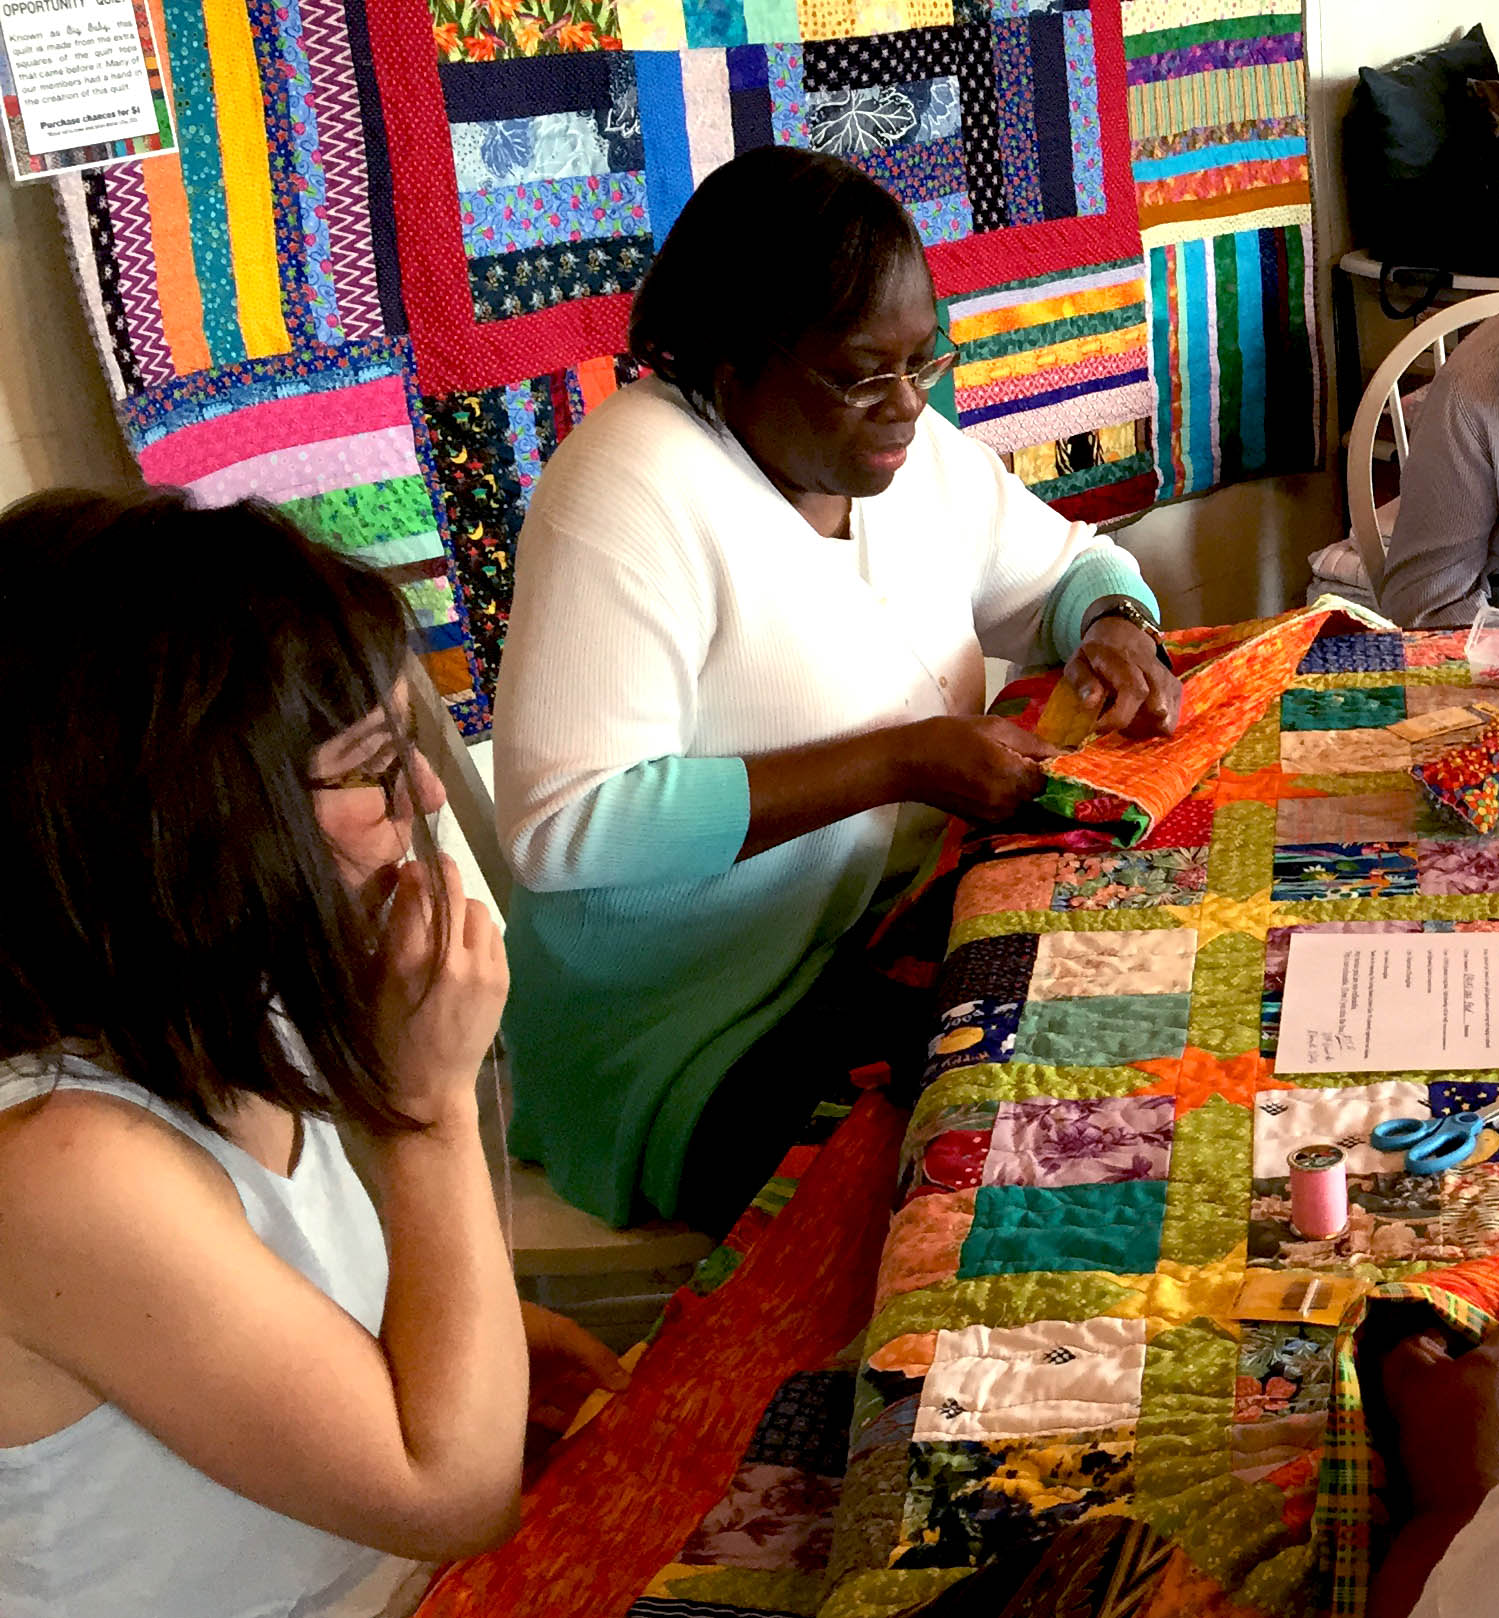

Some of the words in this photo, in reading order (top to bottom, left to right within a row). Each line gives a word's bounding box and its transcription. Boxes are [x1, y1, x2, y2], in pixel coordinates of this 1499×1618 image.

[3, 0, 86, 16] OPPORTUNITY
[9, 32, 43, 42] Known
[13, 46, 32, 56] quilt
[47, 42, 71, 50] made
[75, 38, 95, 46] from
[114, 33, 135, 41] extra
[16, 58, 52, 68] squares
[59, 54, 67, 62] of
[19, 72, 37, 80] that
[39, 69, 63, 78] came
[66, 65, 94, 74] before
[105, 59, 129, 68] Many
[131, 56, 139, 64] of
[40, 80, 82, 90] members
[84, 75, 101, 84] had
[104, 74, 109, 82] a
[111, 70, 132, 79] hand
[42, 93, 79, 103] creation
[81, 89, 89, 97] of
[40, 118, 80, 130] Purchase
[82, 112, 116, 122] chances
